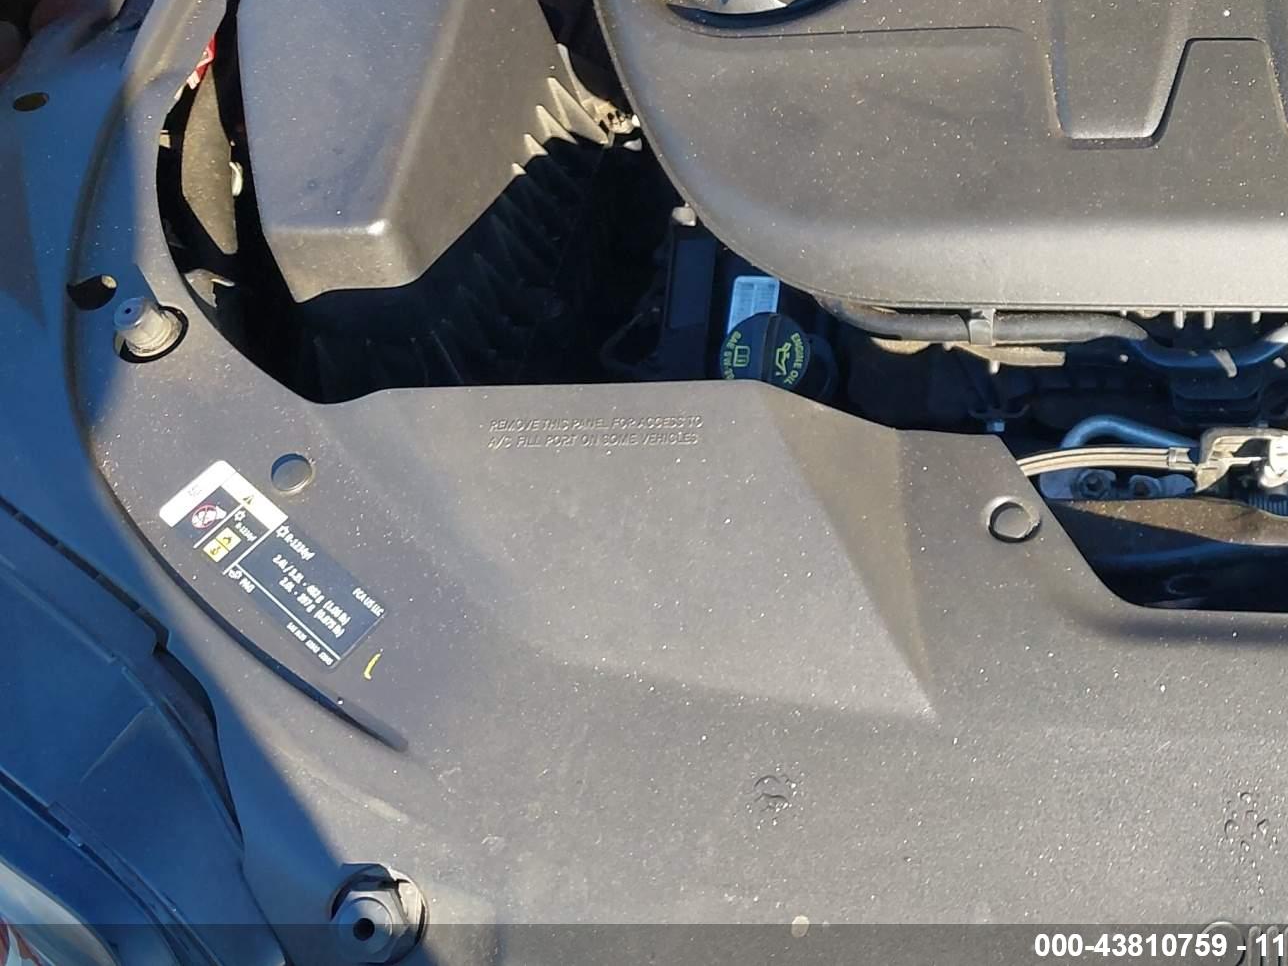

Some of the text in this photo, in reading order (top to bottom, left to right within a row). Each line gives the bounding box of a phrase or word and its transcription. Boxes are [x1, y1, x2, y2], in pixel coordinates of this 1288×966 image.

[783, 333, 804, 384] ENGINE OIL
[490, 416, 704, 431] REMOVE THIS PANEL FOR ACCESS TO
[488, 432, 699, 449] A/C FILL PORT ON SOME VEHICLES
[352, 587, 366, 601] FCA
